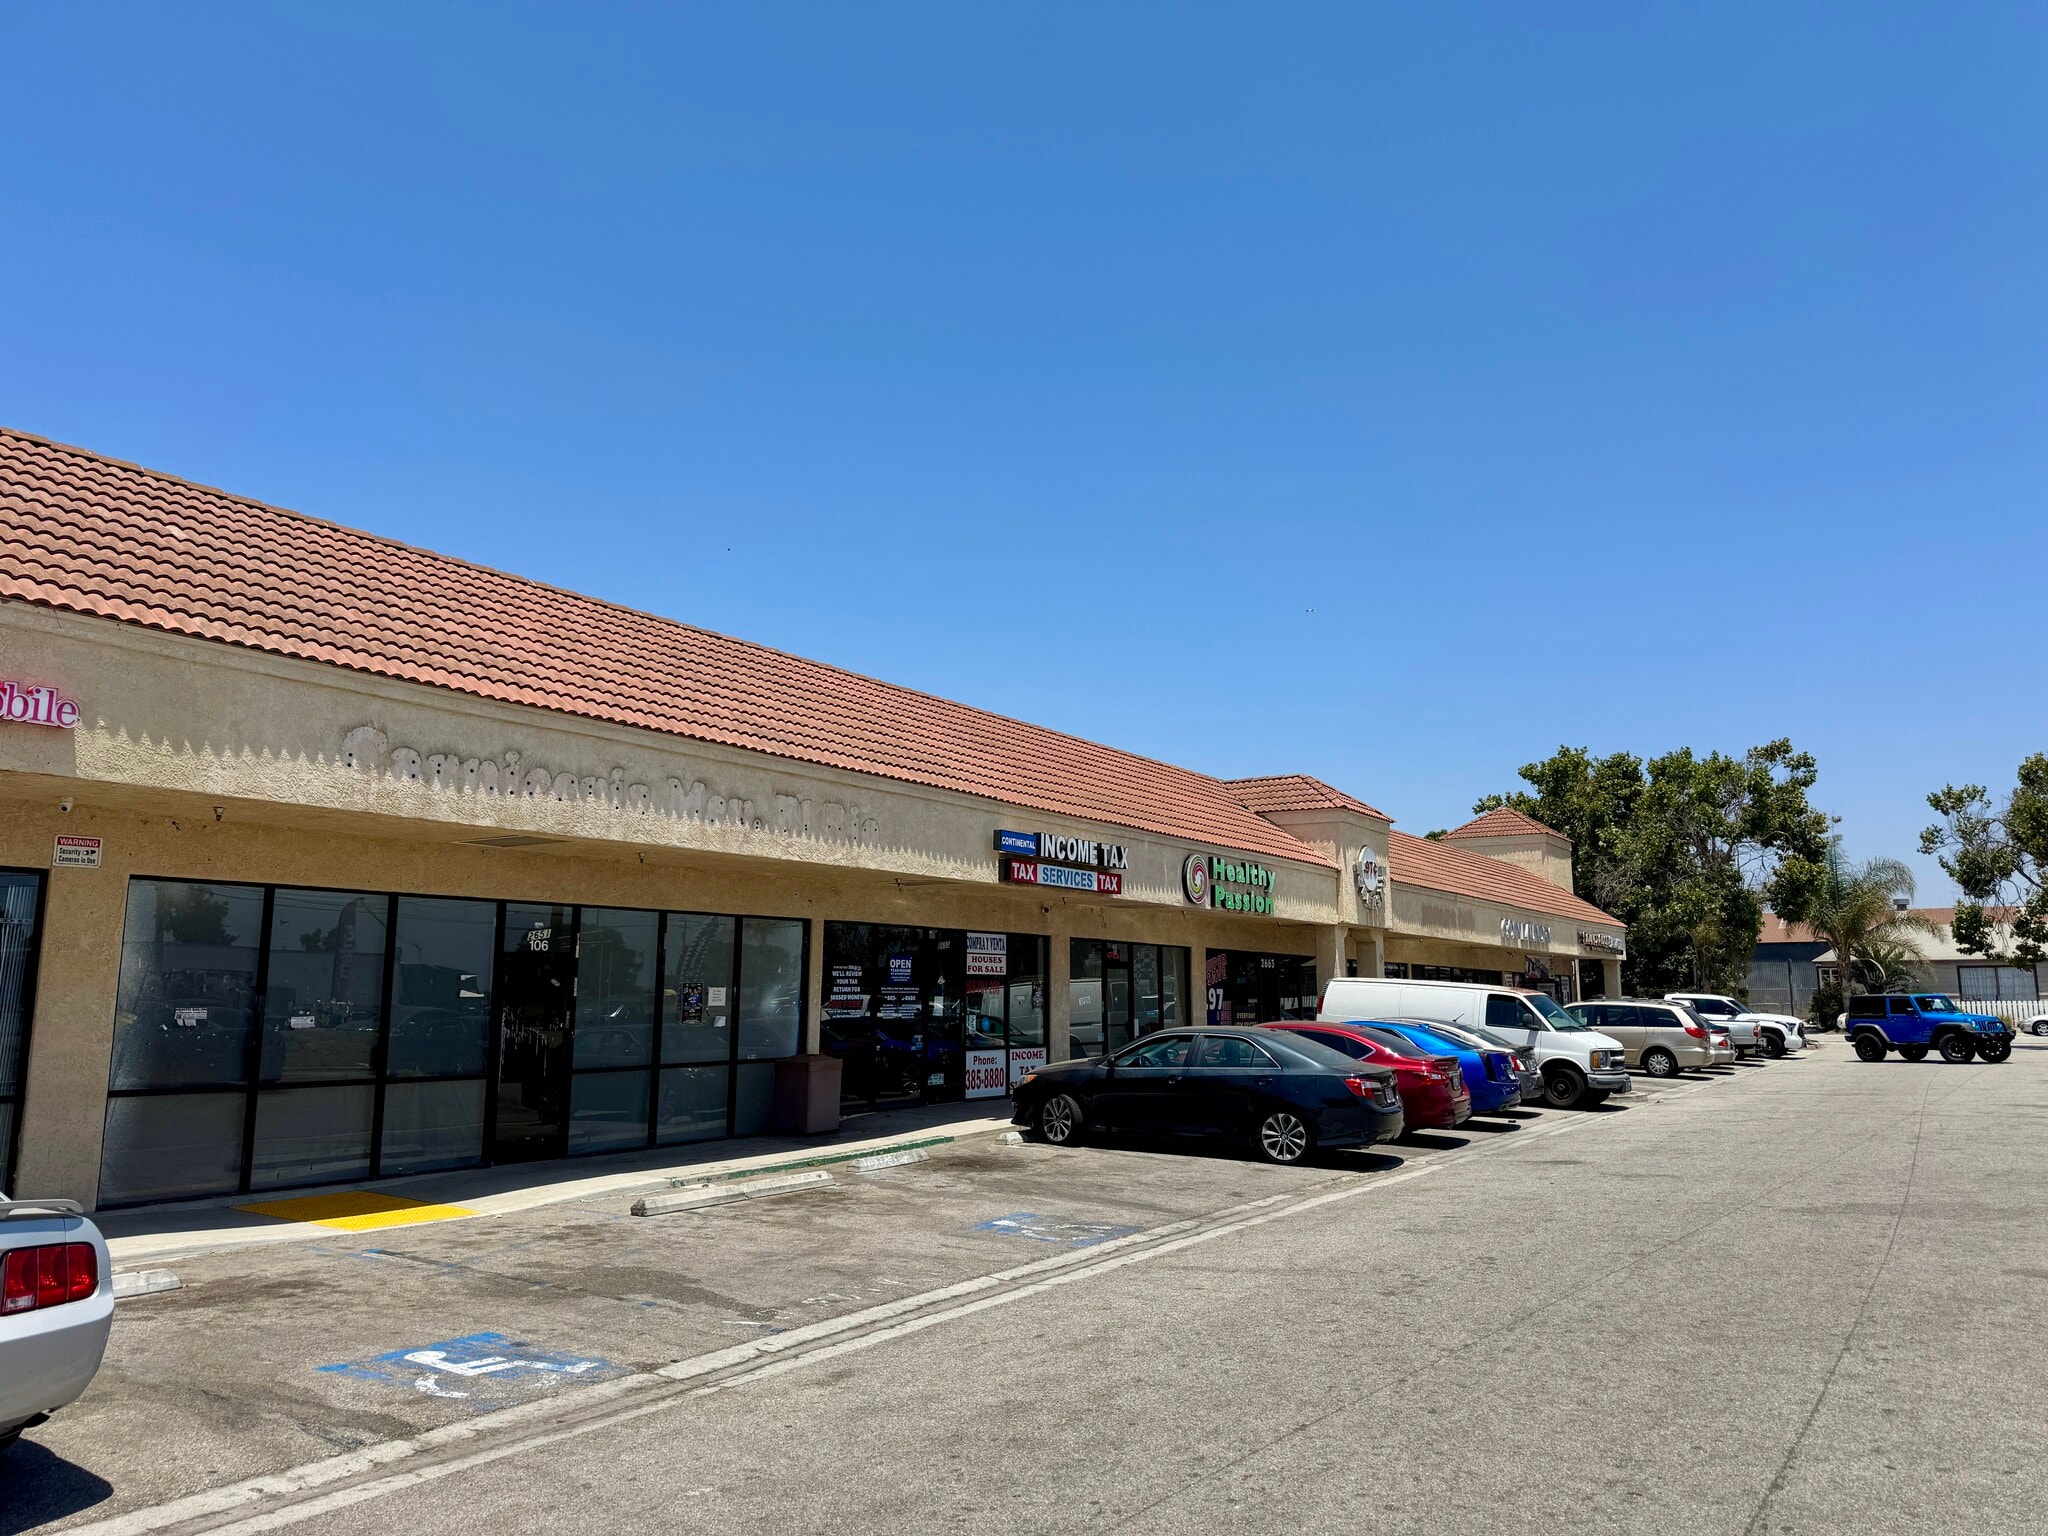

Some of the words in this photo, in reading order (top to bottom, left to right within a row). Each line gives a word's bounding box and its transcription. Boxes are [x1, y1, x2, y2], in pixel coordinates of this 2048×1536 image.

[0, 682, 79, 727] bile
[60, 837, 99, 847] WARNING
[59, 847, 81, 856] Security
[1001, 836, 1036, 850] CONTINENTAL
[1040, 832, 1098, 865] INCOME
[1101, 843, 1129, 869] TAX
[58, 855, 80, 863] Cameras
[1011, 862, 1035, 881] TAX
[1042, 866, 1093, 889] SERVICES
[1099, 875, 1118, 891] TAX
[1213, 856, 1276, 893] Healthy
[1215, 885, 1275, 914] Passion
[528, 929, 551, 940] 2651
[529, 940, 549, 951] 106
[990, 937, 1005, 951] VENTA
[890, 959, 912, 969] OPEN
[971, 955, 1003, 964] HOUSES
[1260, 958, 1275, 968] 2663
[967, 965, 983, 973] FOR
[984, 965, 1004, 973] SALE
[843, 1000, 862, 1008] FREE
[973, 1055, 998, 1066] Phone:
[1011, 1050, 1044, 1060] INCOME
[966, 1067, 1005, 1090] 385-8880
